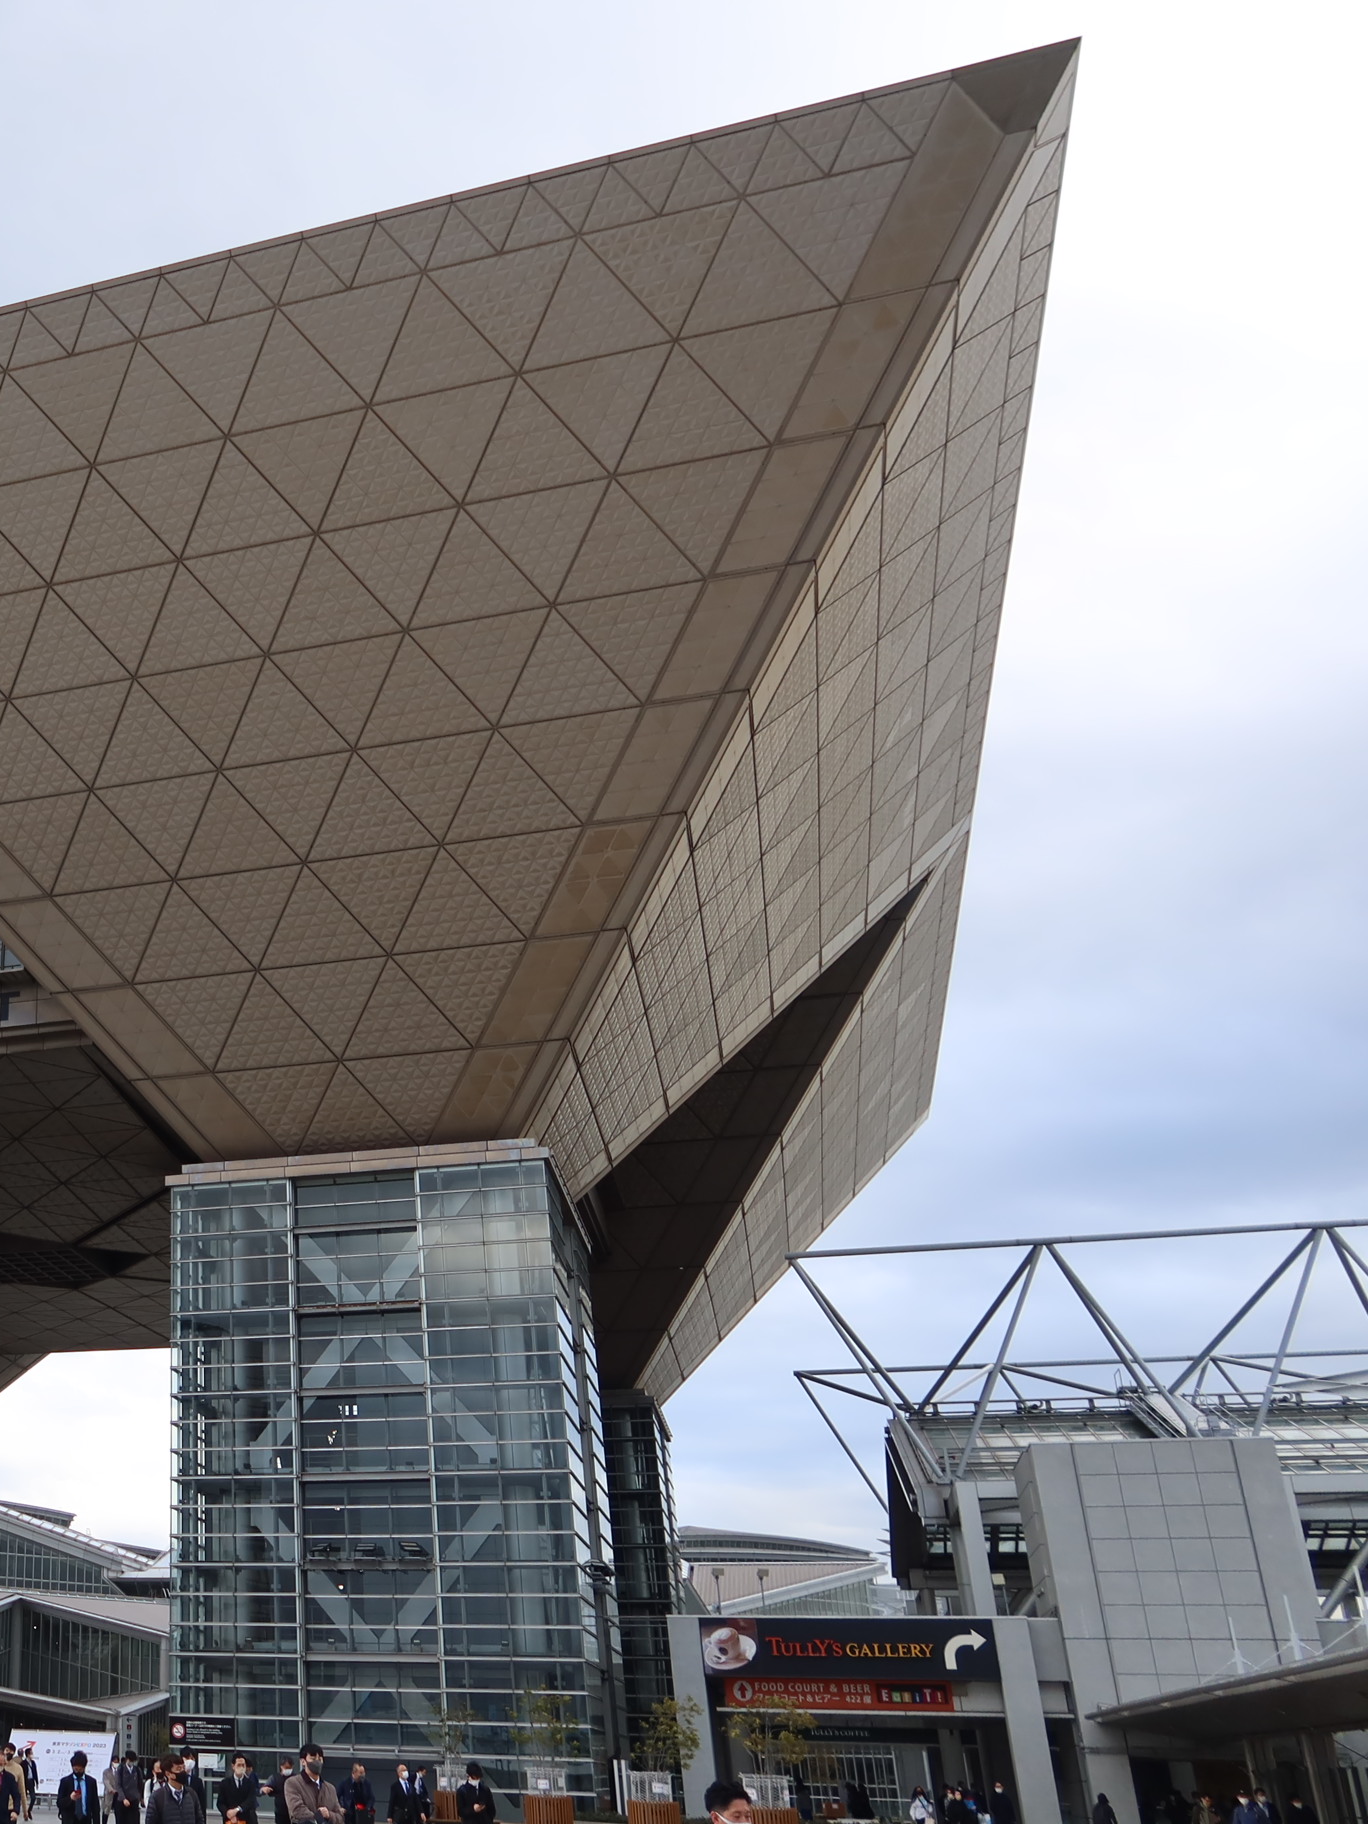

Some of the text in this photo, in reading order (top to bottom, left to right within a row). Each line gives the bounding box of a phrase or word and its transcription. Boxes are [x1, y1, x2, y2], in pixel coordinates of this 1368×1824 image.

[845, 1643, 934, 1658] GALLERY
[754, 1682, 784, 1692] FOOD
[788, 1683, 825, 1693] COURT
[842, 1684, 871, 1694] BEER
